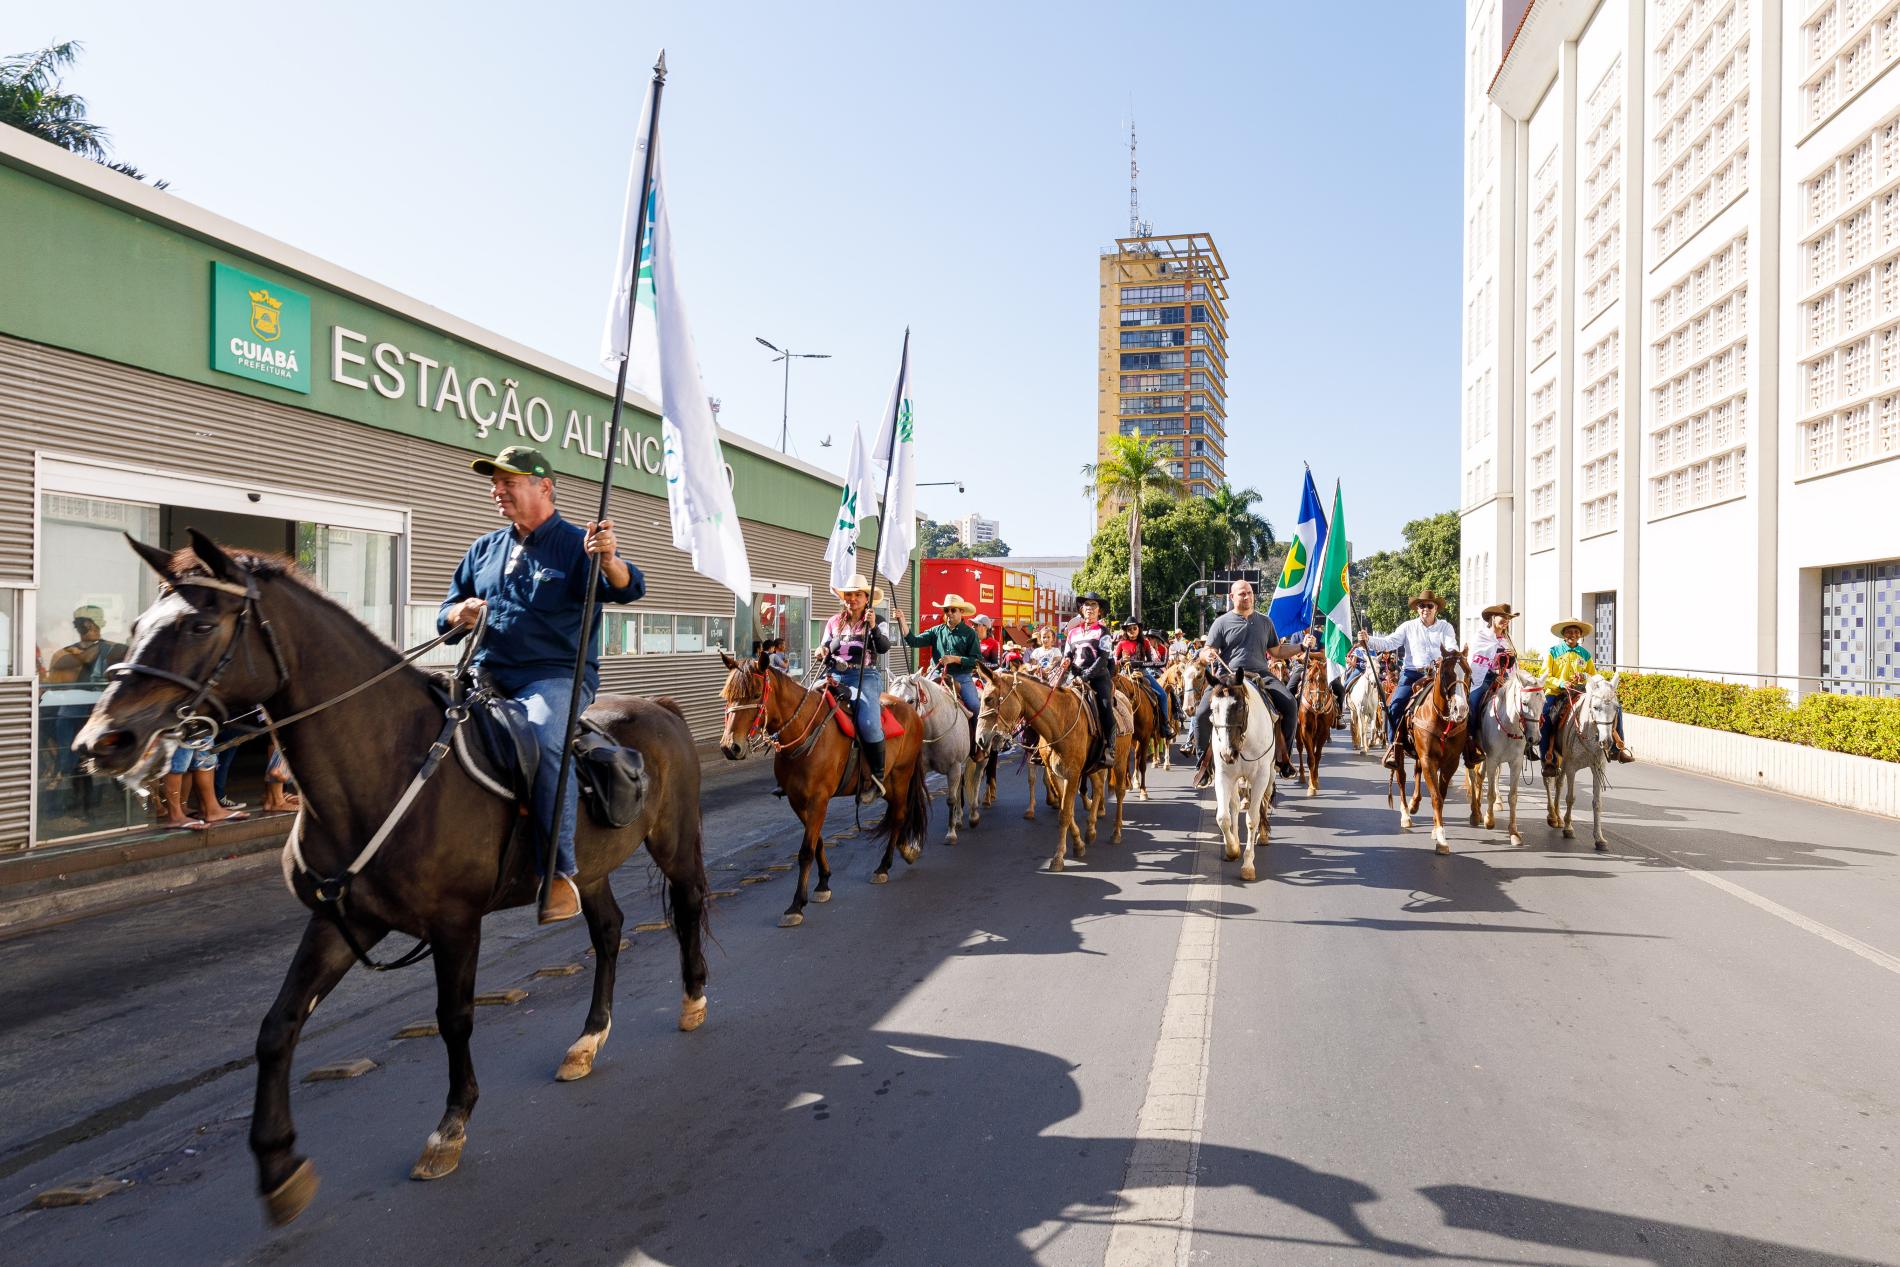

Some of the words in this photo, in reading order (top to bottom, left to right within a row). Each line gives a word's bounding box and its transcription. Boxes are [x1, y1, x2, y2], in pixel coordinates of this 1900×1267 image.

[230, 337, 299, 372] CUIABÁ
[238, 357, 292, 378] PREFEITURA
[330, 325, 554, 443] ESTAÇÃO
